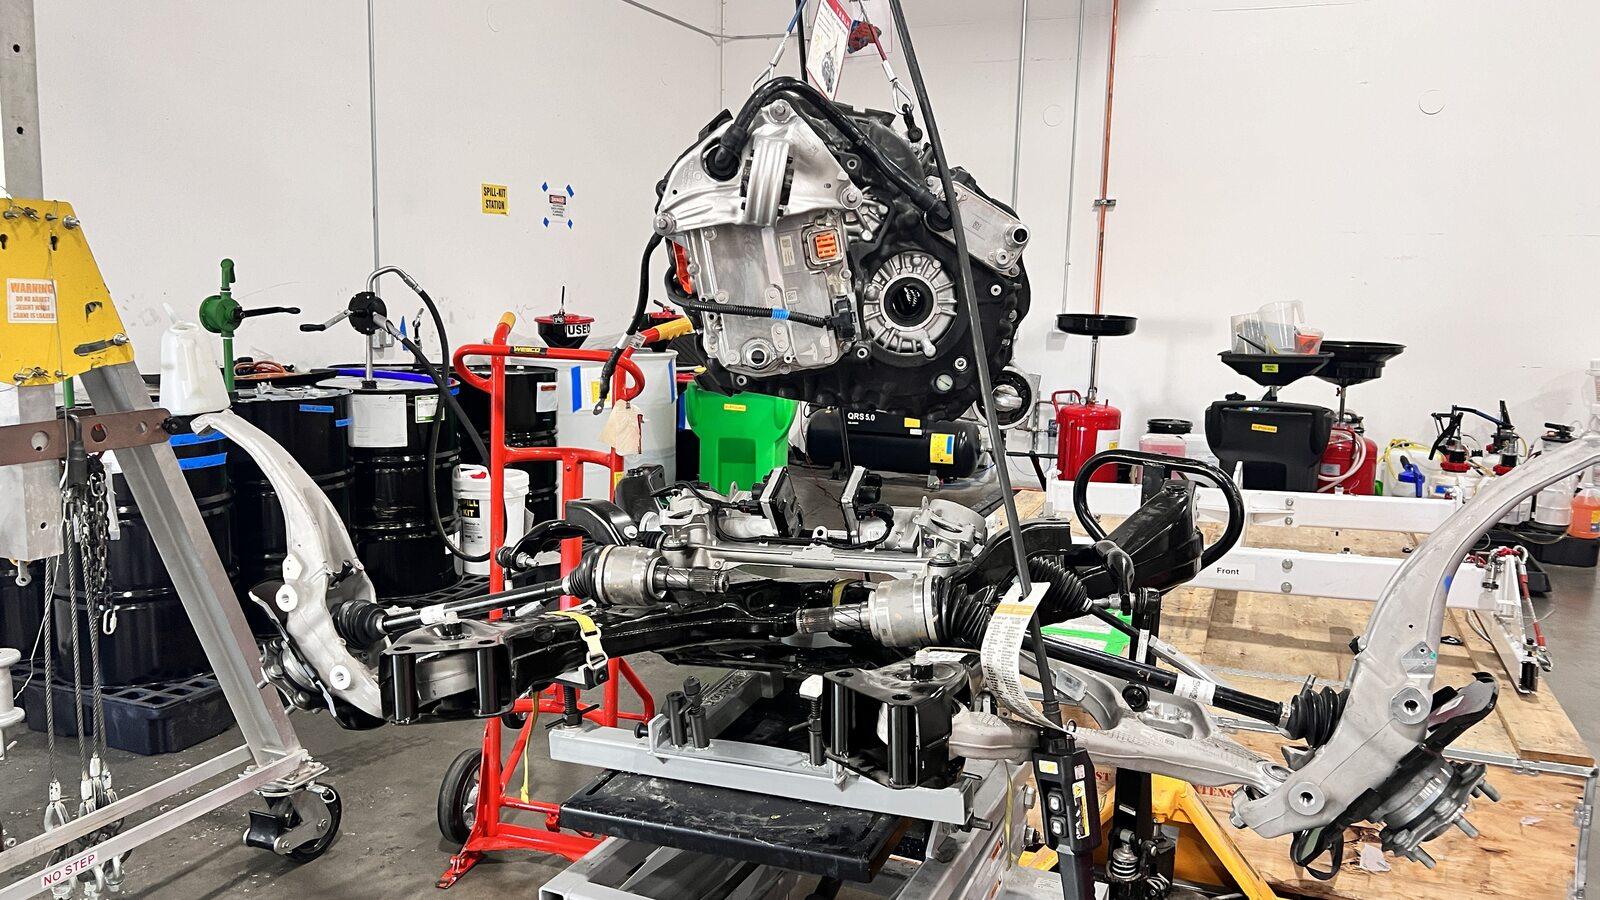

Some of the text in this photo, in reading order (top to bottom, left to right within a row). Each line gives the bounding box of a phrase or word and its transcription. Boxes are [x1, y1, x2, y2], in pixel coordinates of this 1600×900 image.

[483, 186, 506, 198] SPILL-KIT
[485, 199, 505, 210] STATION
[11, 282, 54, 294] WARNING
[567, 324, 590, 335] USED
[847, 412, 876, 422] QRS 5.0
[1216, 567, 1240, 575] Front
[43, 854, 95, 887] NO STEP
